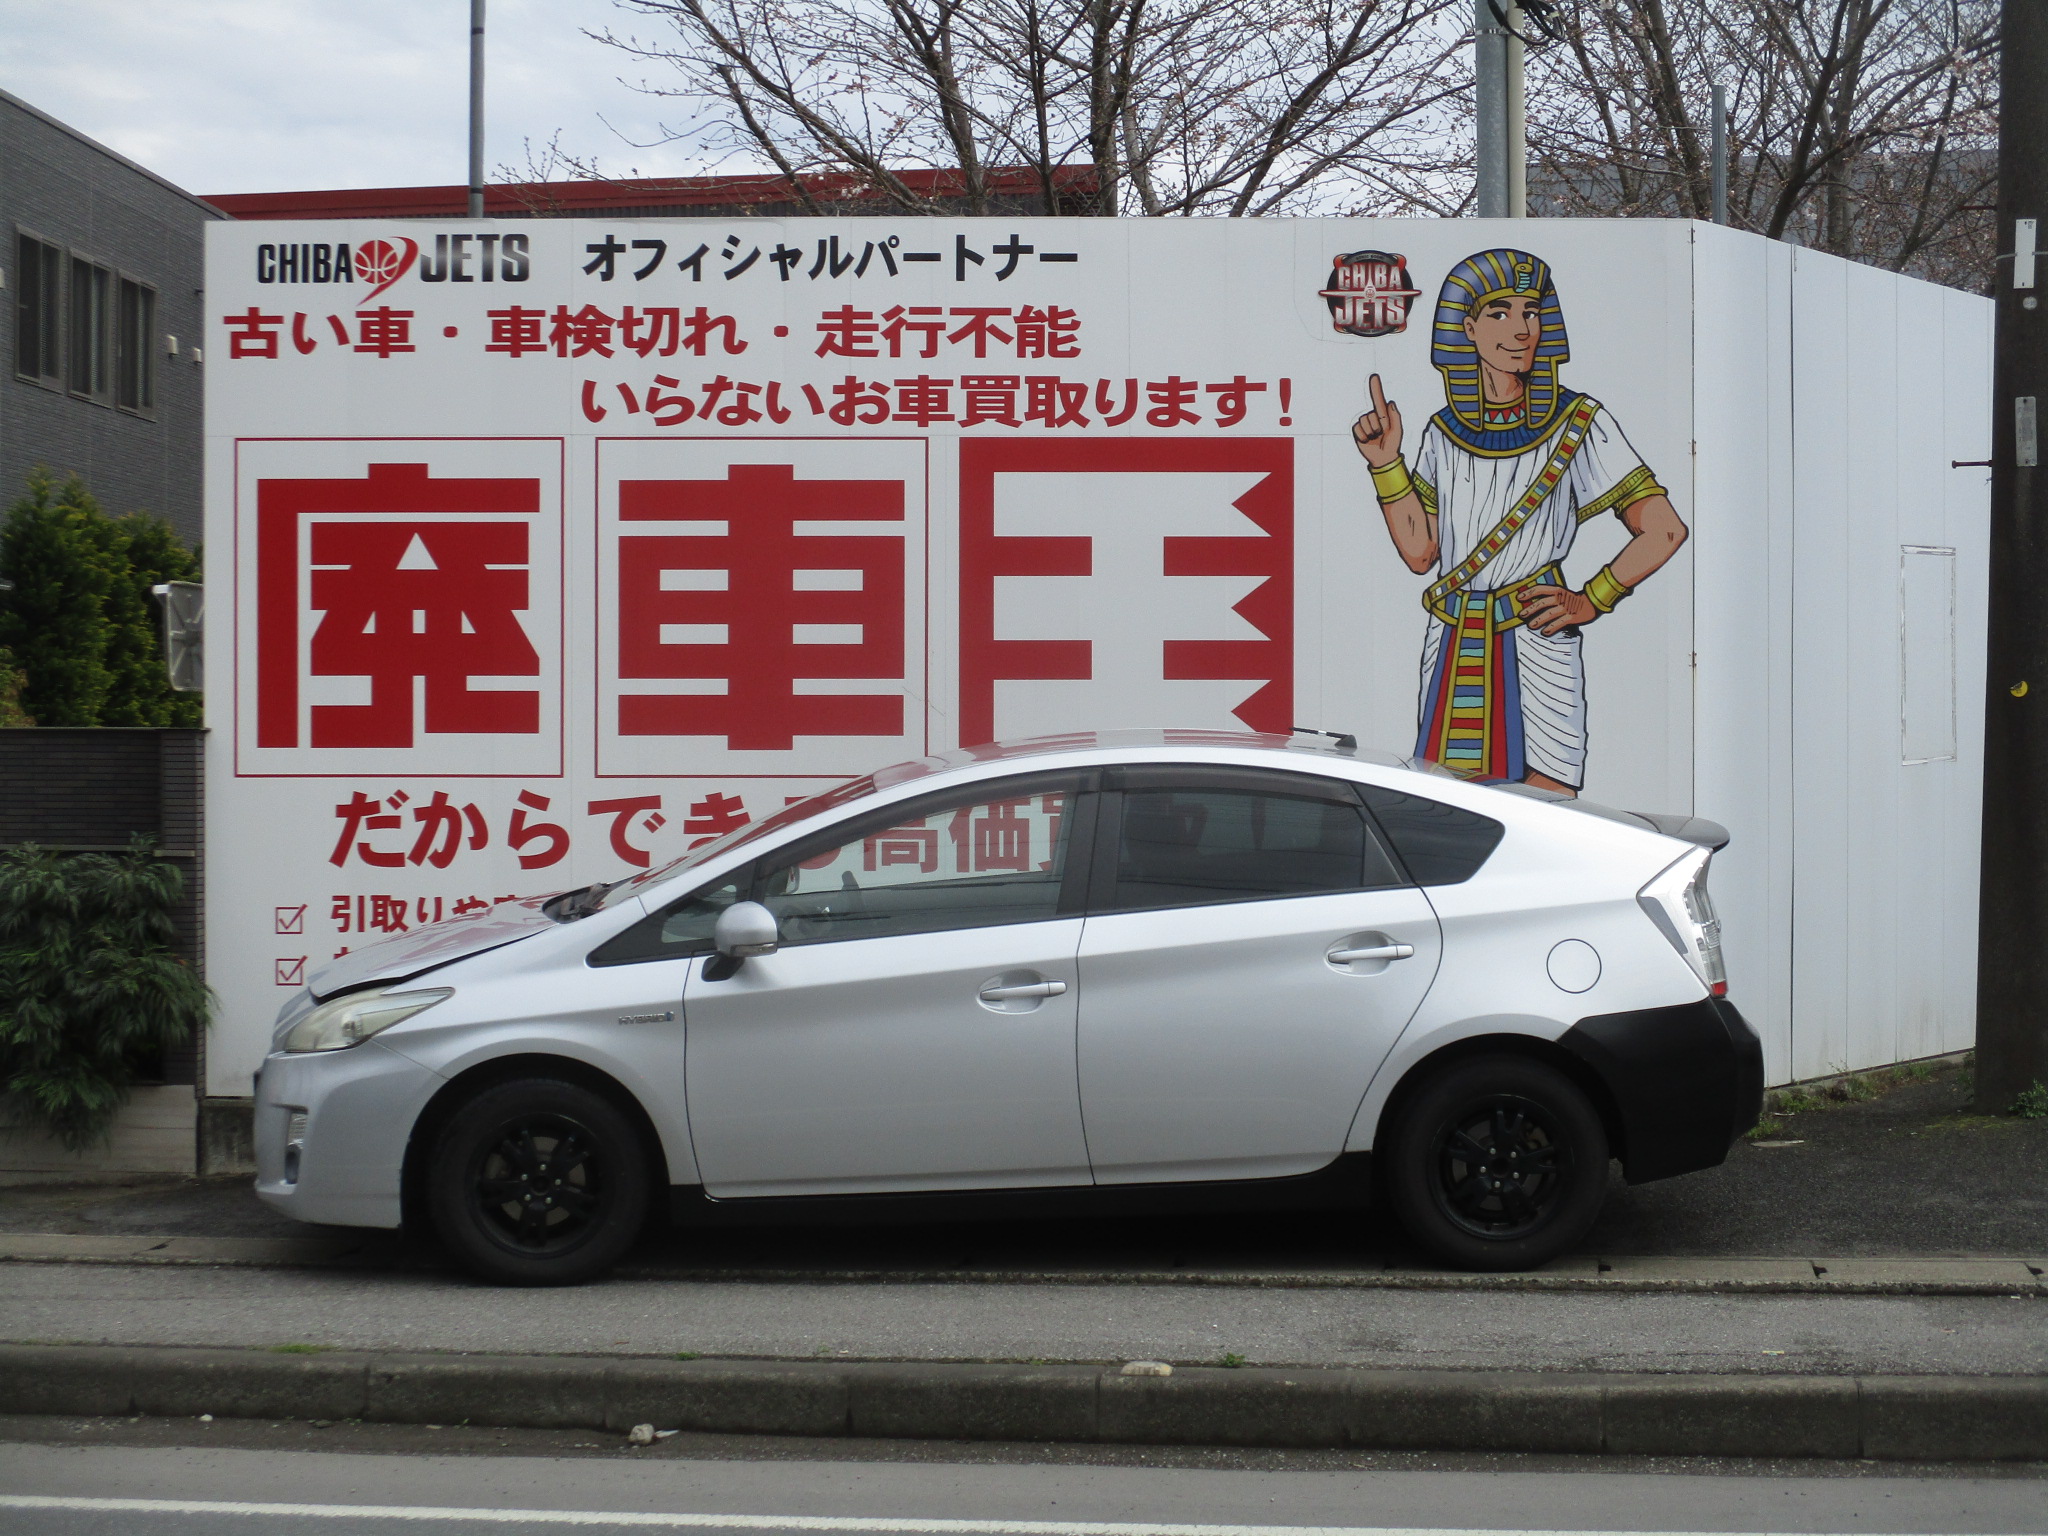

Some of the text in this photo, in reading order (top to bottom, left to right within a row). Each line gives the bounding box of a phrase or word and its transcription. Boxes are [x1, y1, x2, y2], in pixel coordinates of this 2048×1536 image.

[257, 233, 530, 284] CHIBA JETS
[582, 233, 1079, 282] オフィシャルパートナー
[1338, 262, 1403, 290] CHIBA
[223, 303, 1082, 360] 古い車・車検切れ・走行不能
[1335, 295, 1405, 328] JETS
